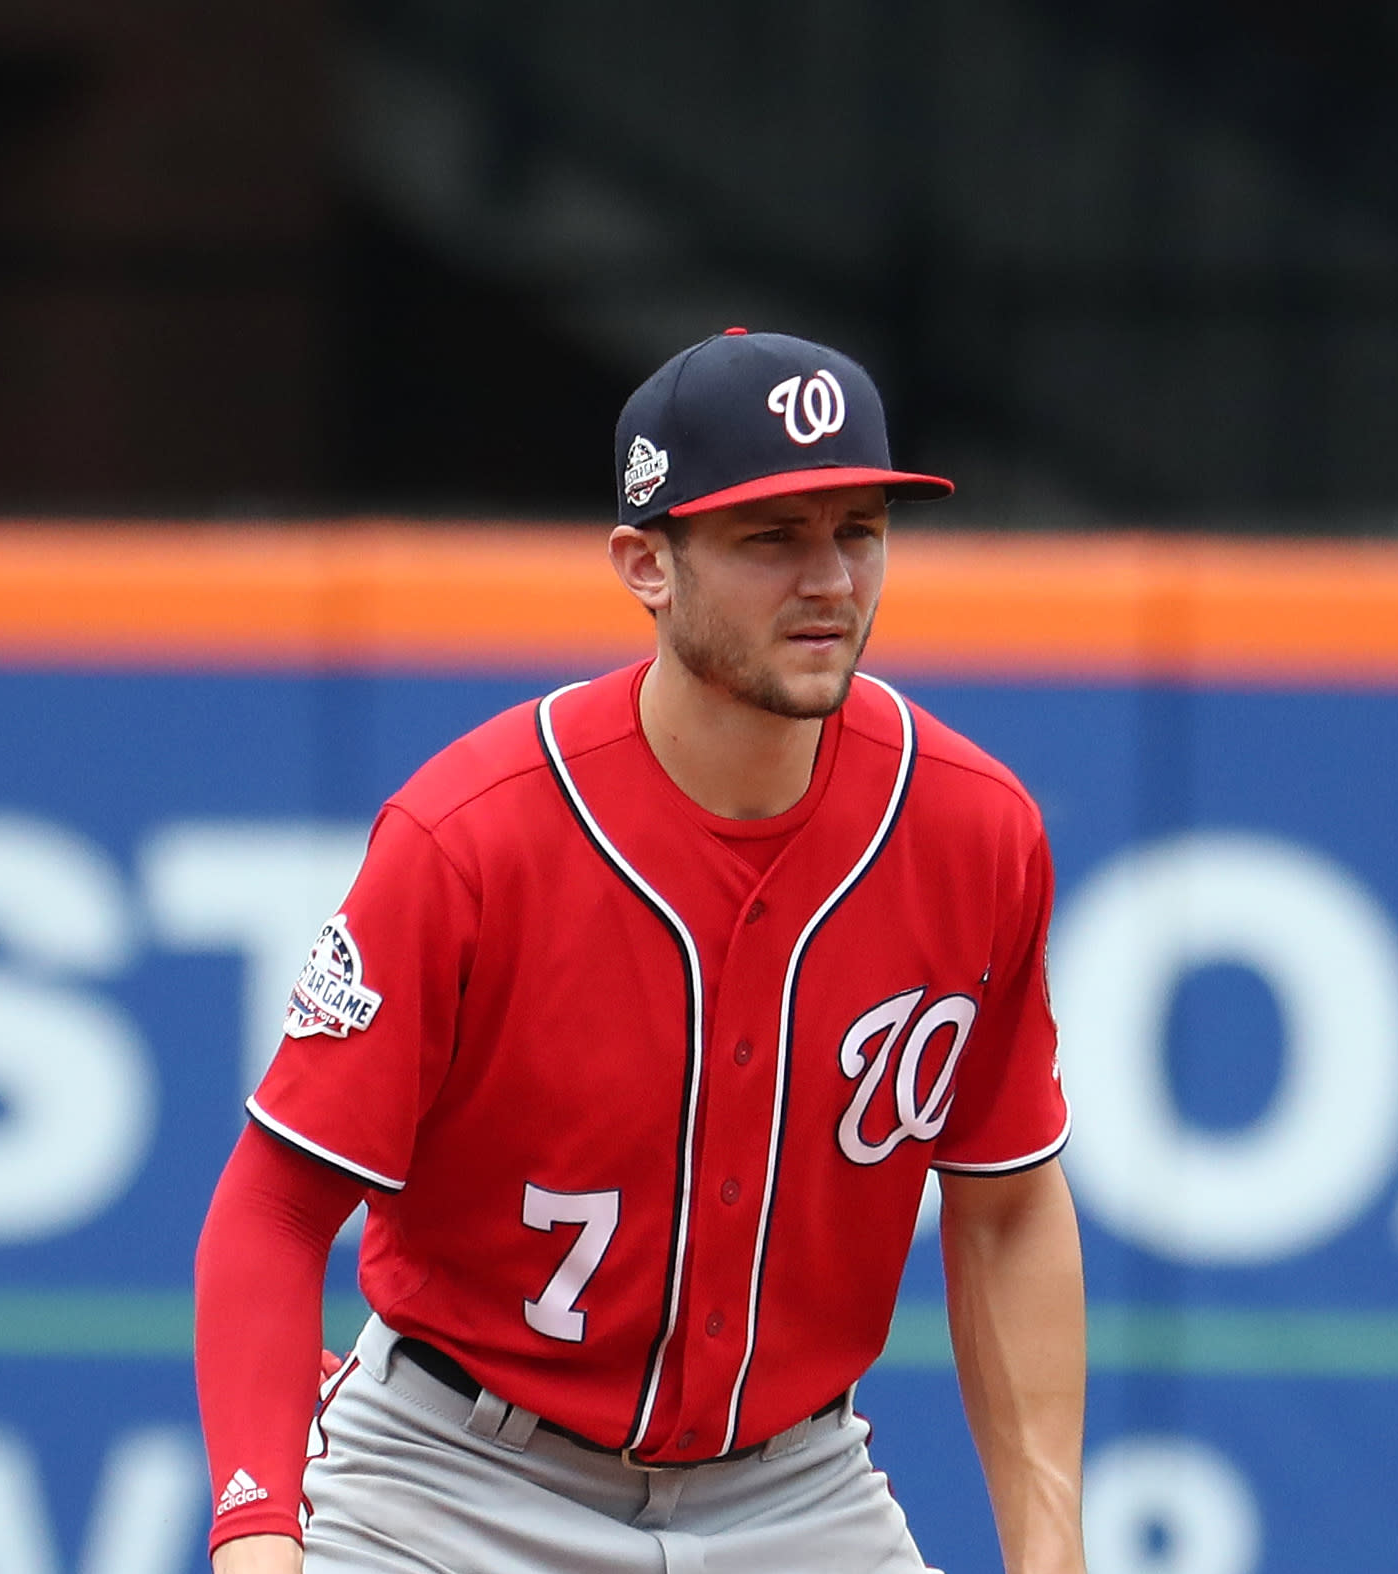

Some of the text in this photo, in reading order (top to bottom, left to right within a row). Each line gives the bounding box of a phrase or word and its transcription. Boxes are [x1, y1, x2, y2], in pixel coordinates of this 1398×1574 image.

[767, 368, 846, 446] W
[323, 979, 372, 1024] GAME
[837, 984, 981, 1167] W
[522, 1181, 621, 1343] 7
[216, 1488, 268, 1515] adidas
